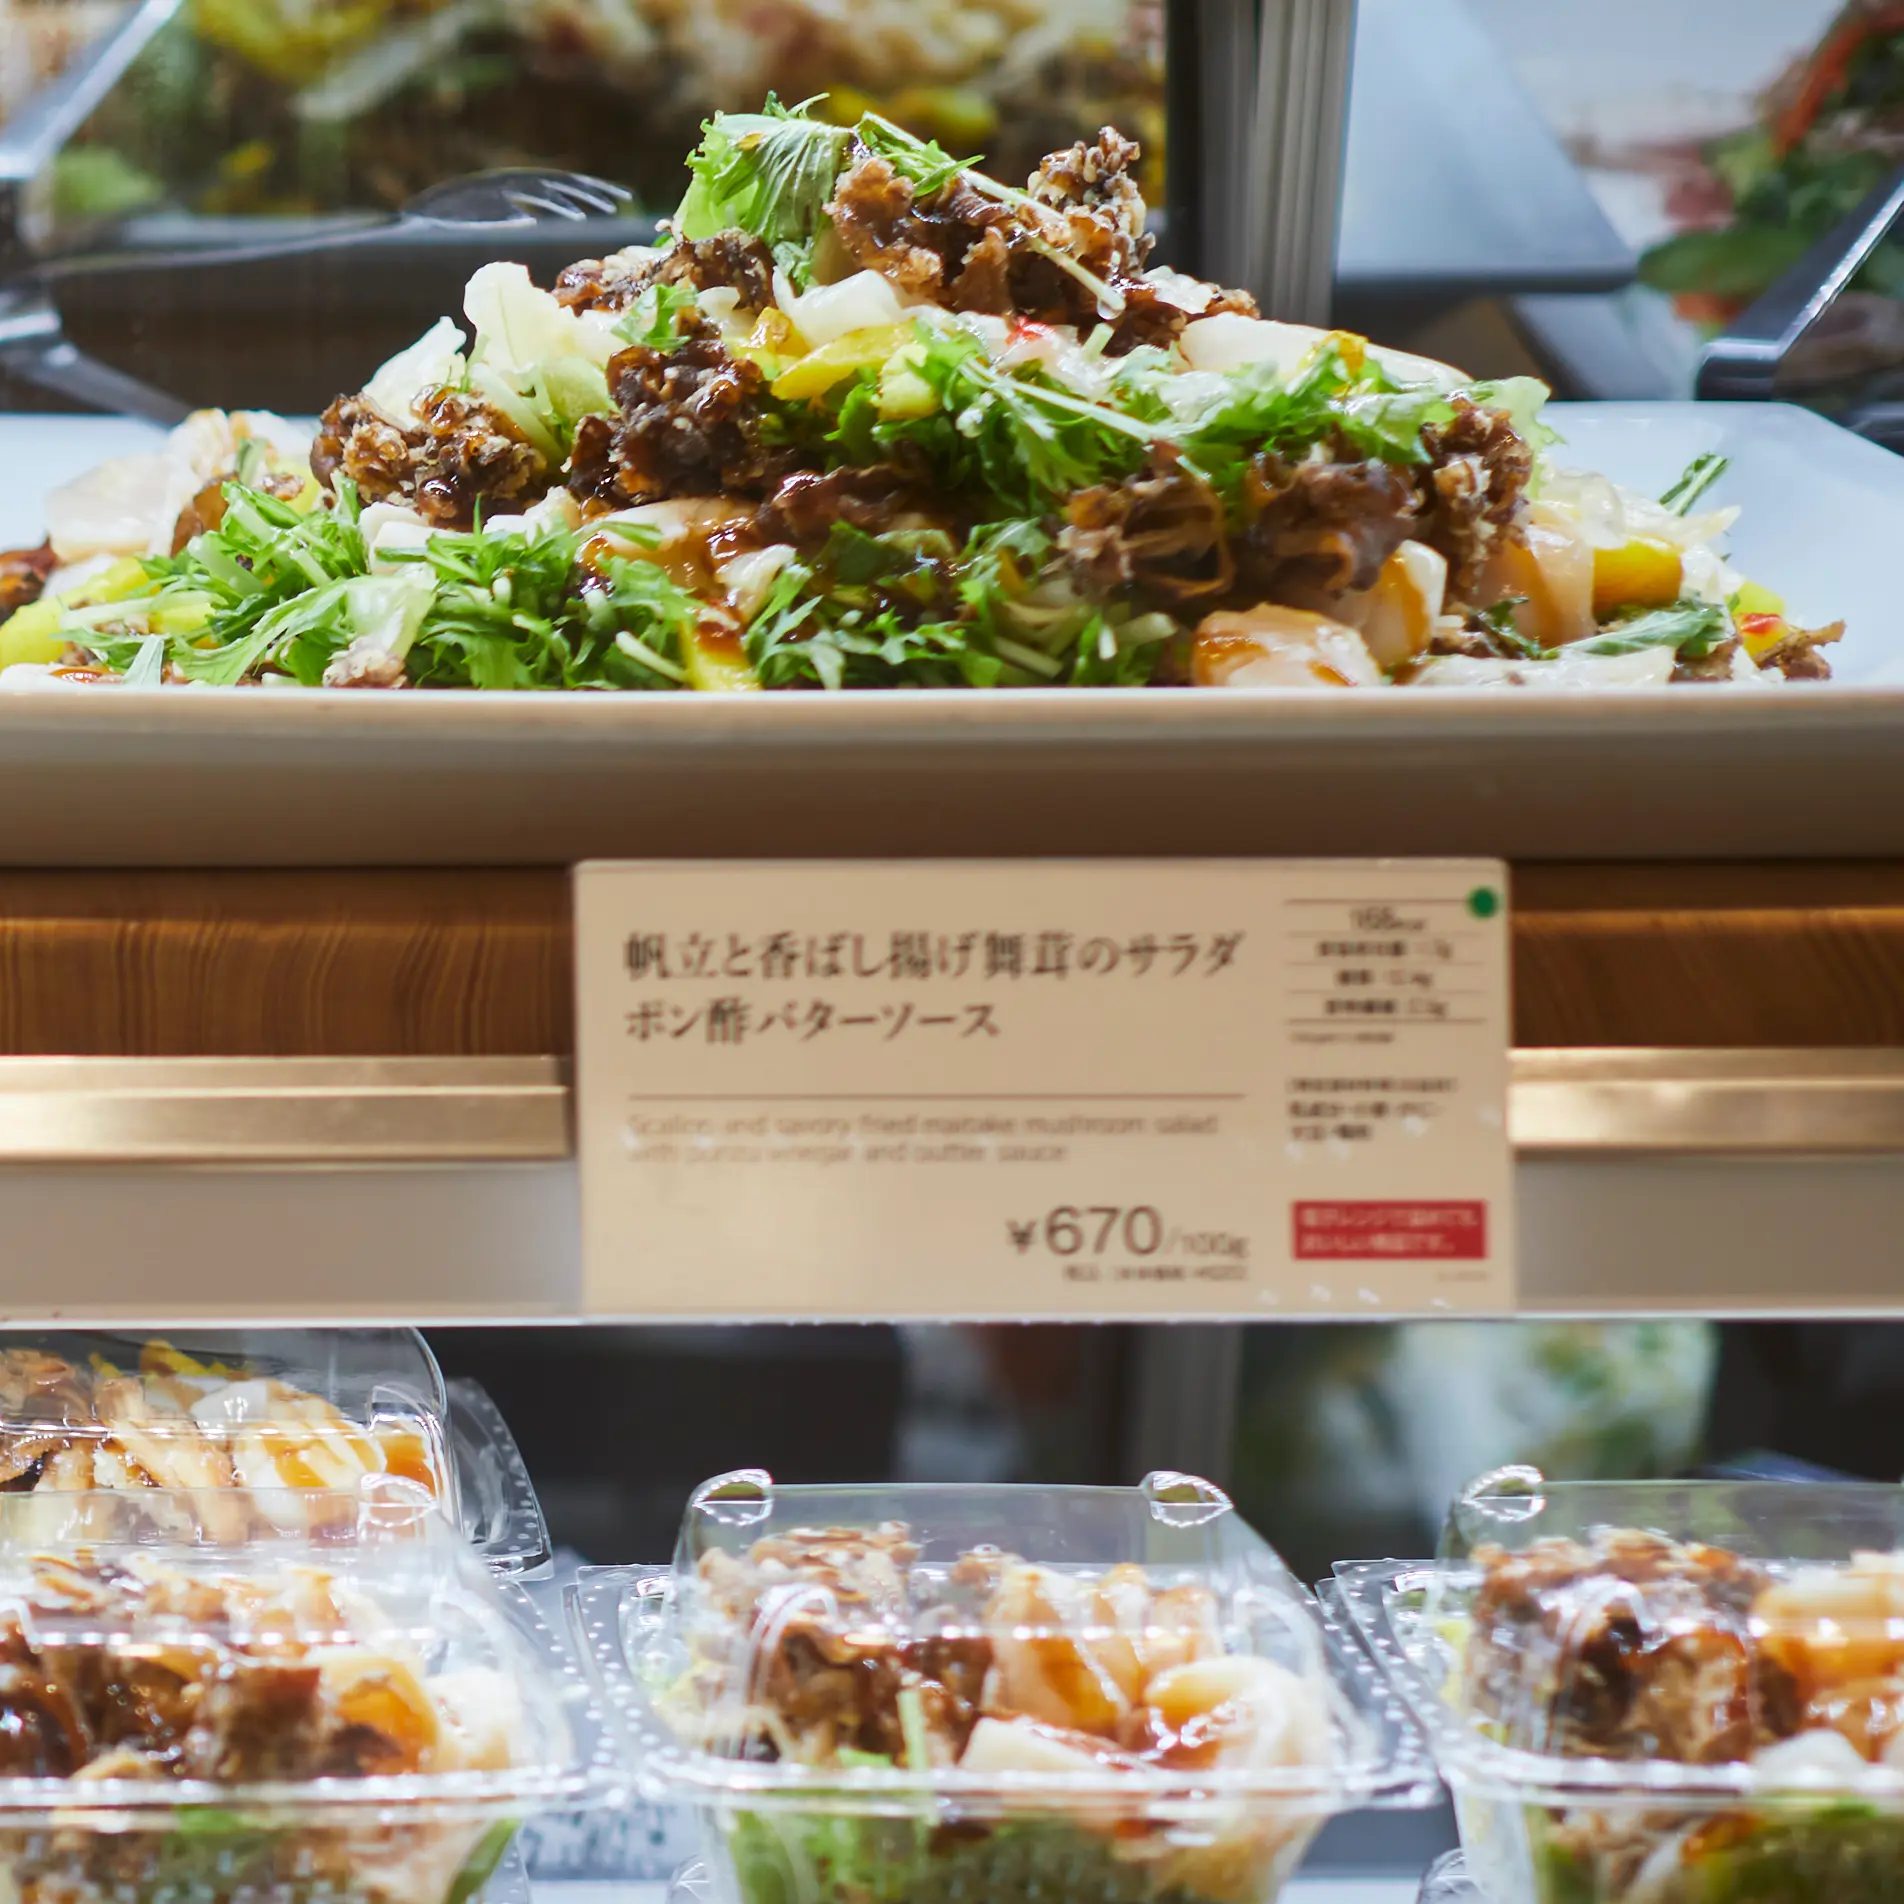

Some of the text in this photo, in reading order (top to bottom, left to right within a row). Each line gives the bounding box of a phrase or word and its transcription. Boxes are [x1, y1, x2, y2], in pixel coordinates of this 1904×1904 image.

[626, 995, 1000, 1045] ポン酢バターソース
